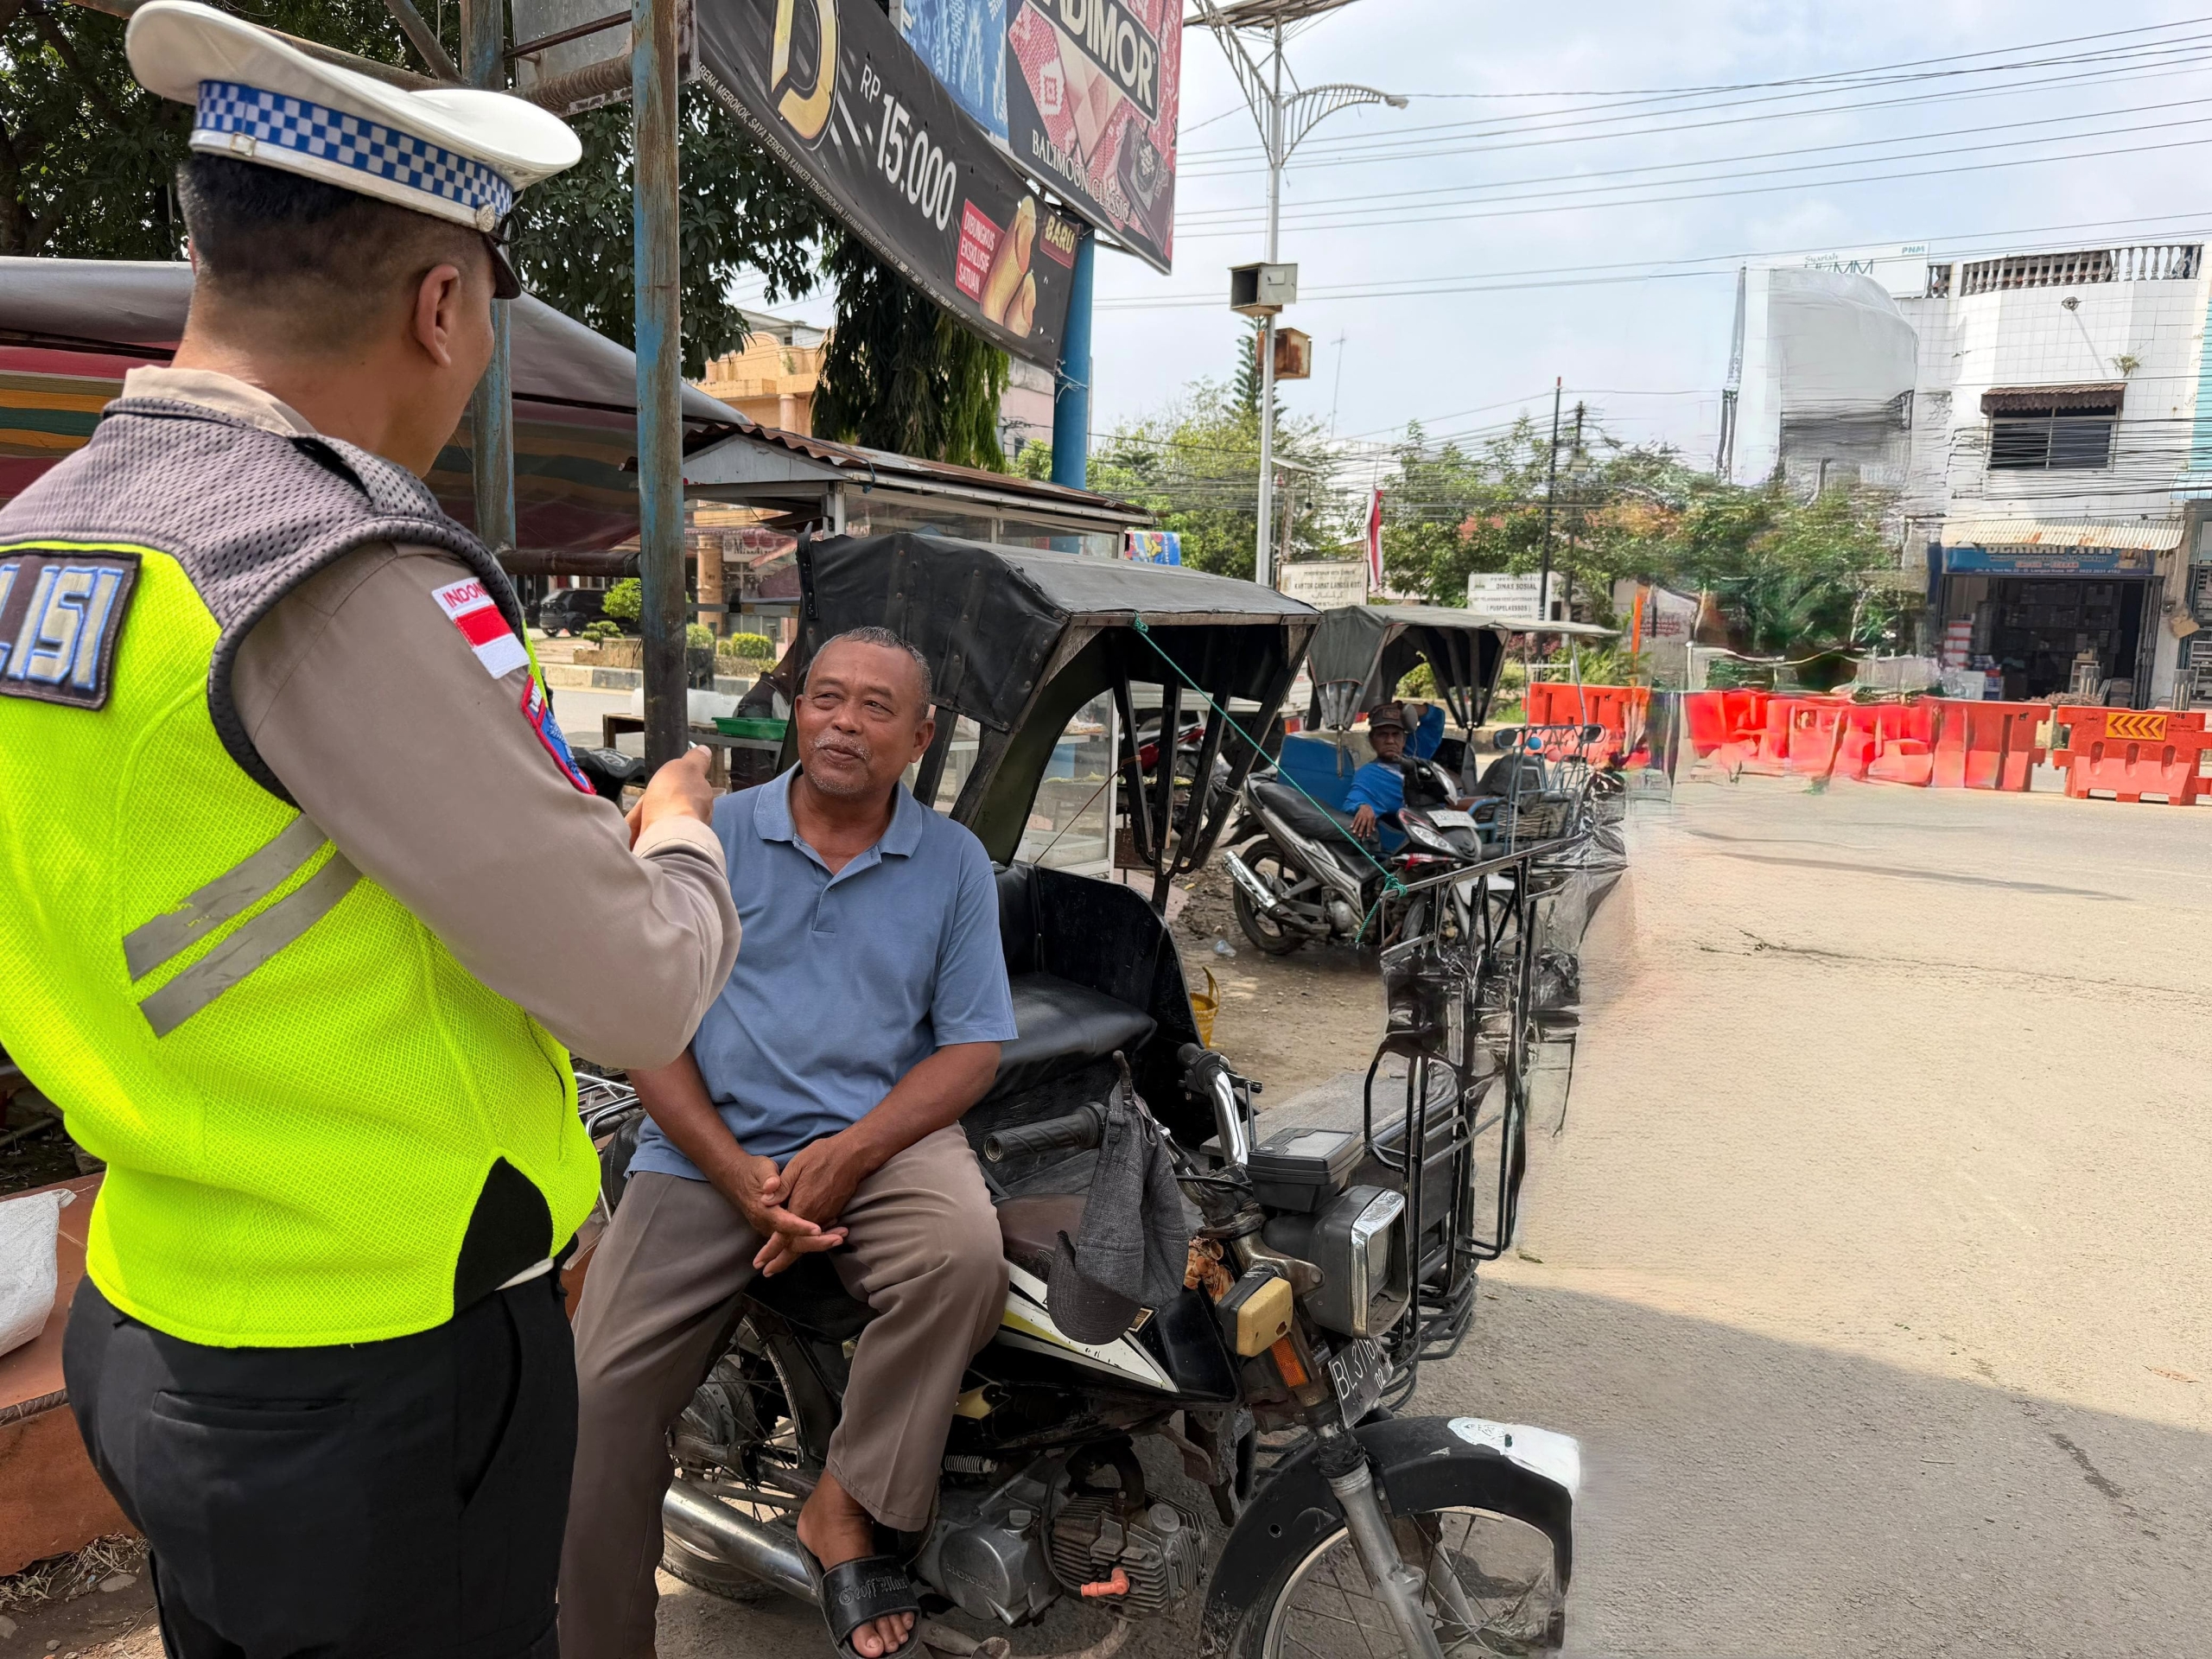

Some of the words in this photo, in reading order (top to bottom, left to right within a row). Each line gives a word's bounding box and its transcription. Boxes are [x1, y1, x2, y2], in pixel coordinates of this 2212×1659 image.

[716, 85, 752, 124] MEROKOK,
[748, 118, 767, 138] SAYA
[764, 133, 791, 162] TERKENA
[787, 157, 811, 182] KANKER
[860, 64, 881, 104] RP
[877, 93, 957, 232] 15.000
[1032, 129, 1089, 194] BALIMOON
[1091, 178, 1131, 225] CLASSIC
[1046, 214, 1076, 254] BARU
[1901, 245, 1925, 254] PNM
[957, 263, 981, 295] SATUAN
[1332, 1356, 1357, 1400] BL
[838, 1577, 877, 1605] Geoff
[946, 1562, 998, 1593] HONDA
